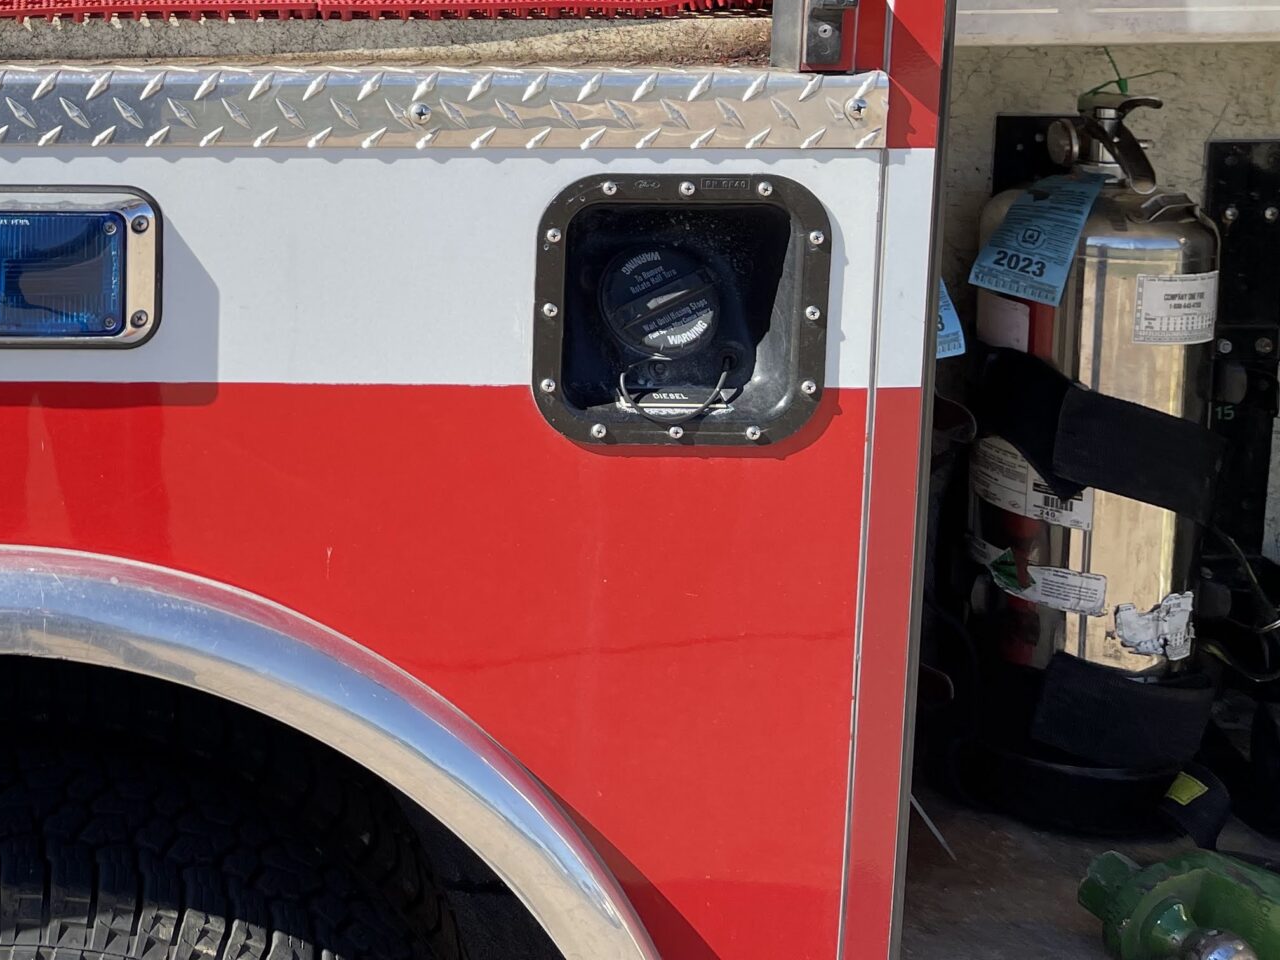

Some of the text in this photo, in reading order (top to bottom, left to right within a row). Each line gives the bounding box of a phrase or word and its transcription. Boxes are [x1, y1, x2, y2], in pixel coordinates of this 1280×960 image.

[621, 251, 661, 275] WARNING
[992, 249, 1047, 278] 2023
[629, 280, 652, 294] Rotate
[642, 320, 657, 332] Wait
[656, 315, 671, 327] Until
[689, 297, 708, 311] Stops
[667, 319, 708, 345] WARNING
[652, 392, 689, 400] DIESEL
[1216, 405, 1235, 420] 15
